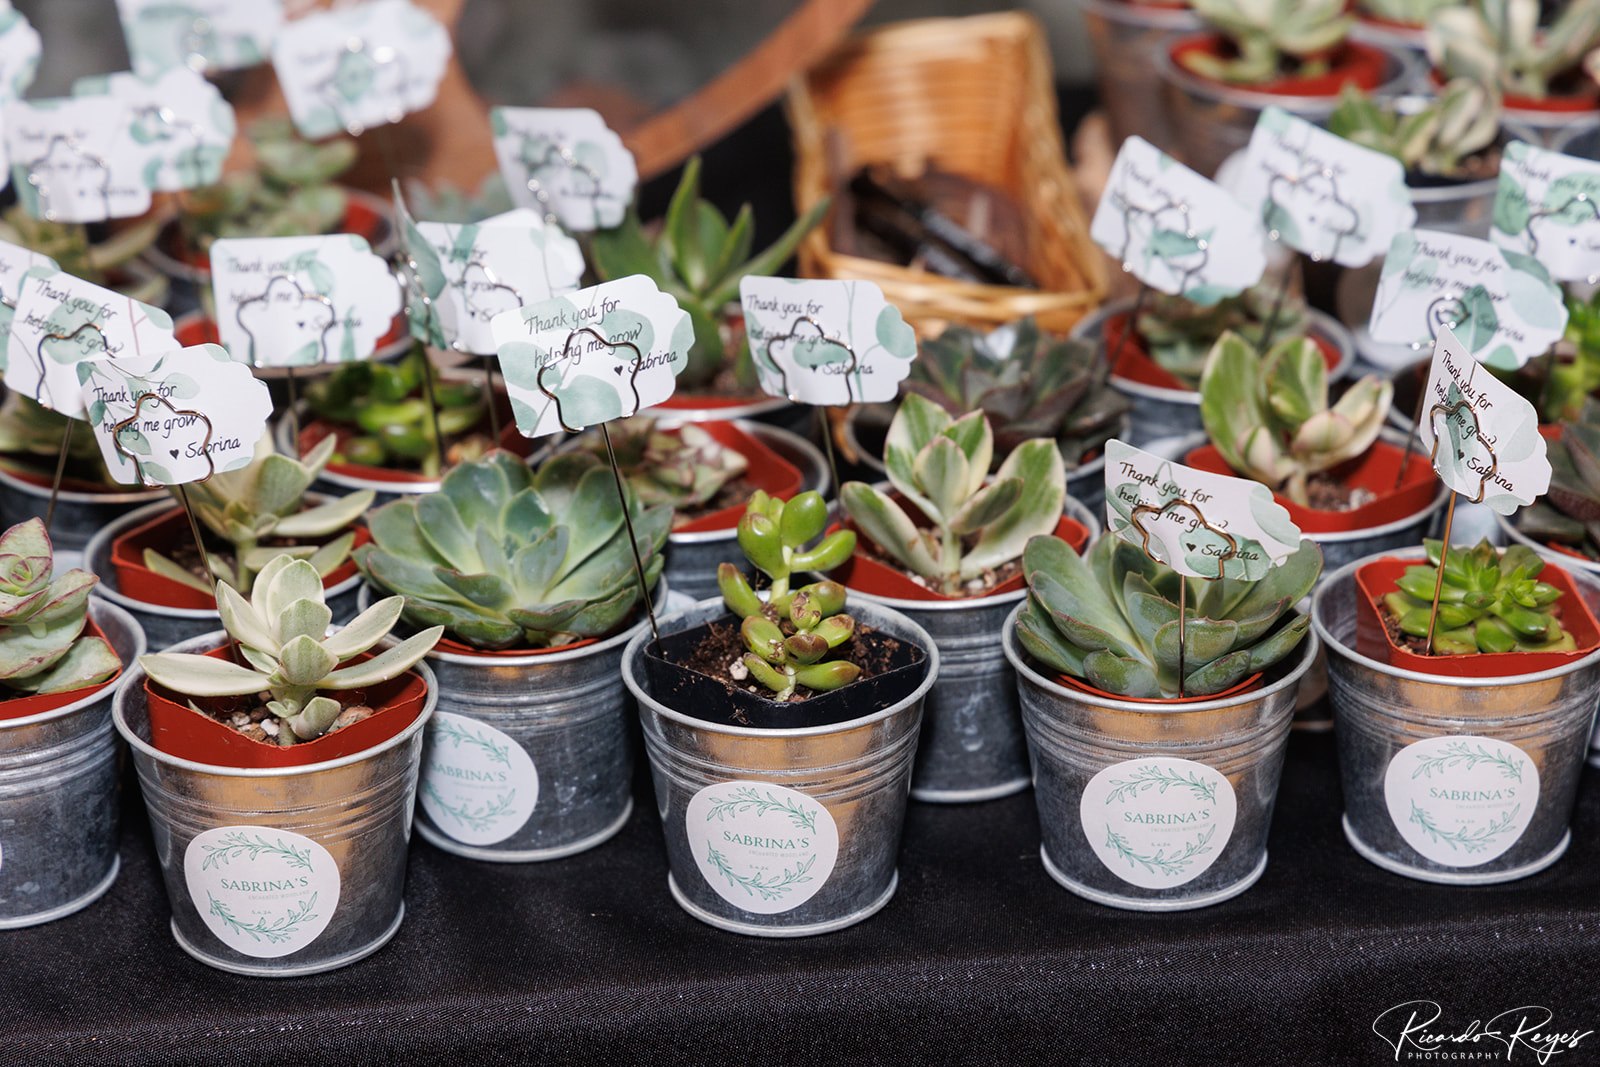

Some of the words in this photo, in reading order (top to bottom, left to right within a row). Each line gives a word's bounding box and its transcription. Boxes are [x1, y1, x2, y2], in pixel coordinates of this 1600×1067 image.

[1412, 241, 1451, 259] Thank
[1448, 254, 1478, 268] you
[1470, 258, 1501, 275] for
[37, 278, 70, 305] Thank
[66, 296, 96, 315] you
[87, 302, 118, 324] for
[746, 294, 779, 311] Thank
[779, 304, 803, 320] you
[803, 299, 824, 318] for
[523, 311, 569, 336] Thank
[570, 303, 598, 329] you
[594, 296, 621, 326] for
[627, 350, 679, 374] Sabrina
[1442, 349, 1462, 385] Thank
[1456, 379, 1476, 400] you
[1473, 392, 1494, 411] for
[92, 381, 130, 403] Thank
[129, 388, 154, 409] you
[150, 381, 178, 408] for
[143, 421, 161, 433] me
[163, 413, 199, 439] grow
[1454, 412, 1467, 428] me
[1119, 461, 1160, 489] Thank
[1156, 483, 1187, 503] you
[1189, 487, 1214, 504] for
[1165, 510, 1187, 524] me
[1429, 787, 1516, 802] SABRINA'S
[1123, 808, 1211, 825] SABRINA'S
[723, 830, 810, 850] SABRINA'S
[220, 876, 309, 893] SABRINA'S
